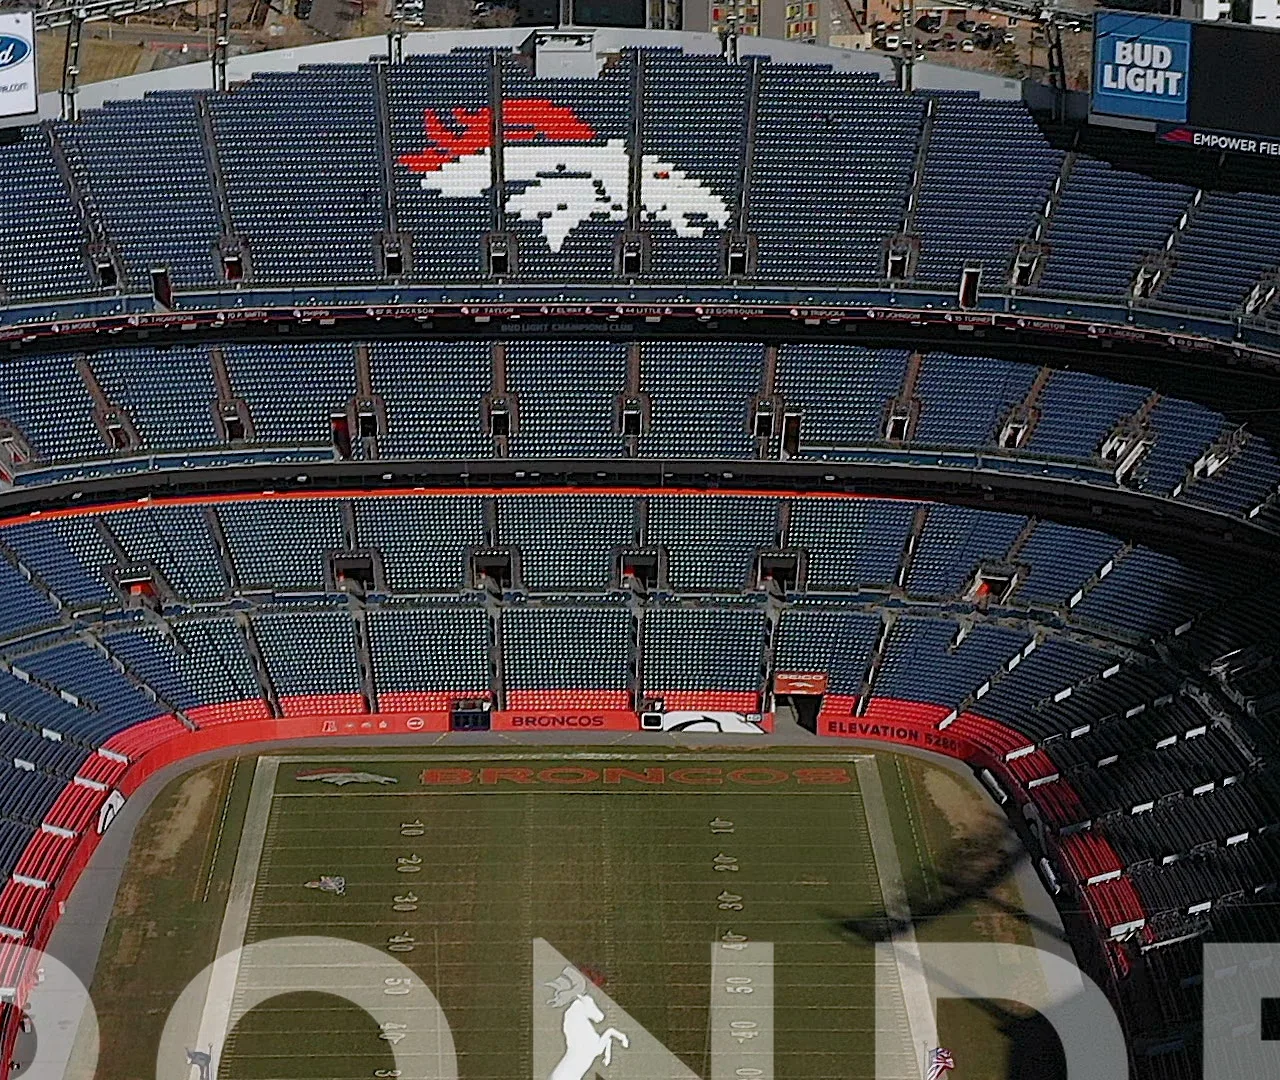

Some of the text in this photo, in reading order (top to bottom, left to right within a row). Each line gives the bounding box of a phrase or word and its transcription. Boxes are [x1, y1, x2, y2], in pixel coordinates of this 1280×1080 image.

[1115, 41, 1172, 70] BUD
[1103, 64, 1182, 97] LIGHT
[1193, 133, 1257, 153] EMPOWER
[395, 307, 435, 315] JACKSON
[777, 673, 825, 682] GEICO
[511, 714, 605, 728] BRONCOS
[828, 720, 958, 751] ELEVATION 5280
[420, 767, 852, 786] BRONCOS
[726, 977, 754, 994] 50
